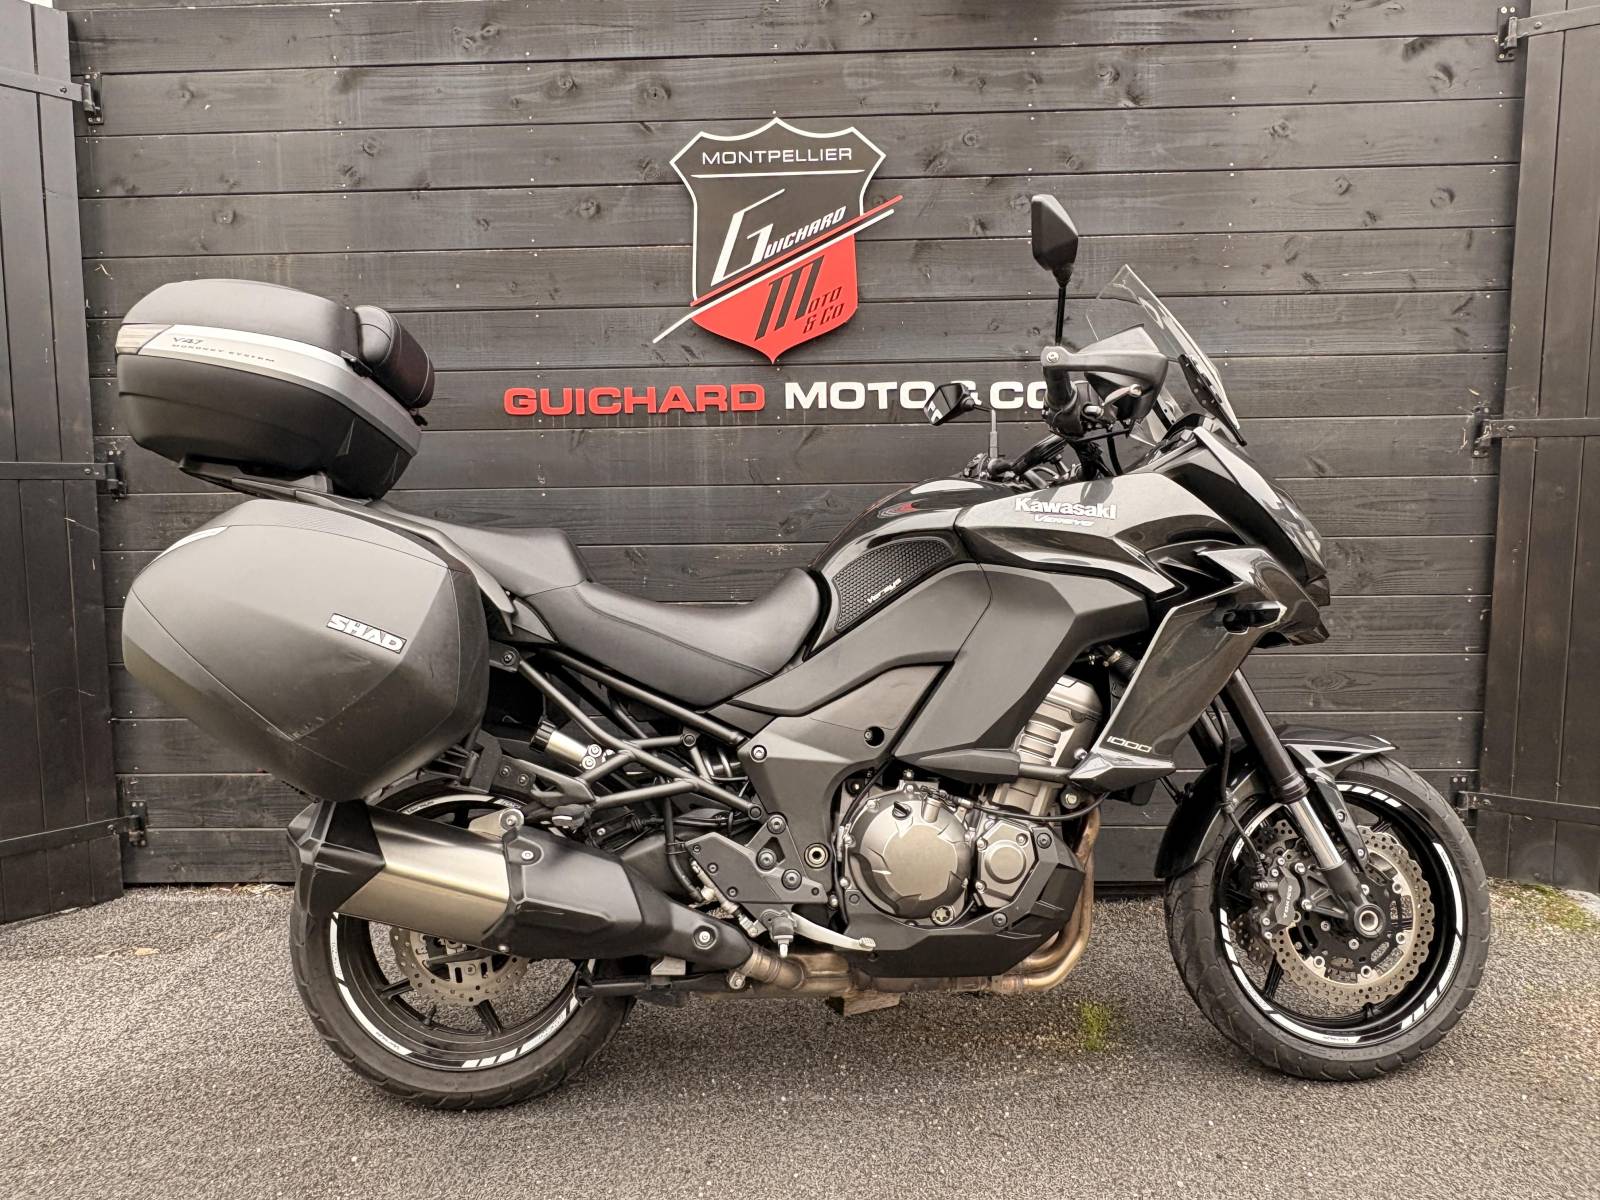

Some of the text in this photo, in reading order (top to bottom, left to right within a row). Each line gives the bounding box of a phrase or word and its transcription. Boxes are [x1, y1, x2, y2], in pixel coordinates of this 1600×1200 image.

[702, 147, 852, 165] MONTPELLIER
[711, 188, 847, 287] GUICHARD
[503, 383, 766, 416] GUICHARD
[785, 380, 936, 410] MOTO
[1015, 497, 1117, 520] Kawasaki
[326, 612, 407, 654] SHAD
[1106, 735, 1153, 753] 1000
